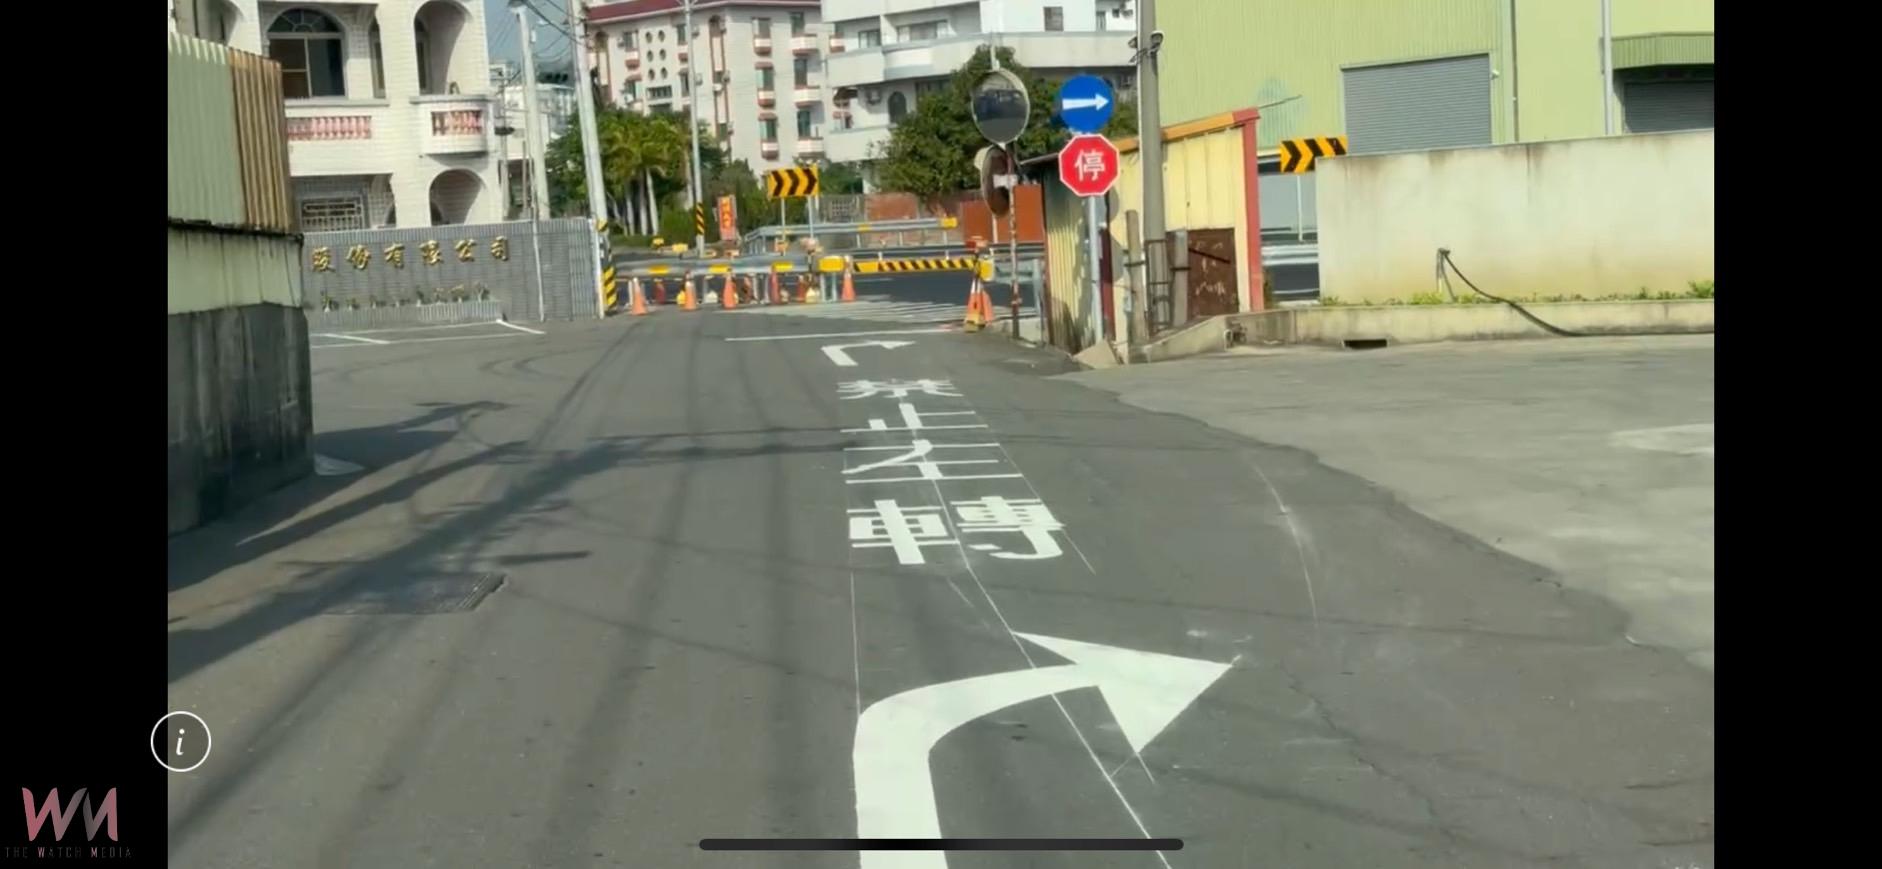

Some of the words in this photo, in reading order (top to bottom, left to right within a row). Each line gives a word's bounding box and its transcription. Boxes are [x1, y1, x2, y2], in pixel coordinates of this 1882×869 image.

[1074, 149, 1106, 181] 停
[312, 235, 509, 273] 股份有限公司
[836, 377, 1067, 564] 禁止左轉
